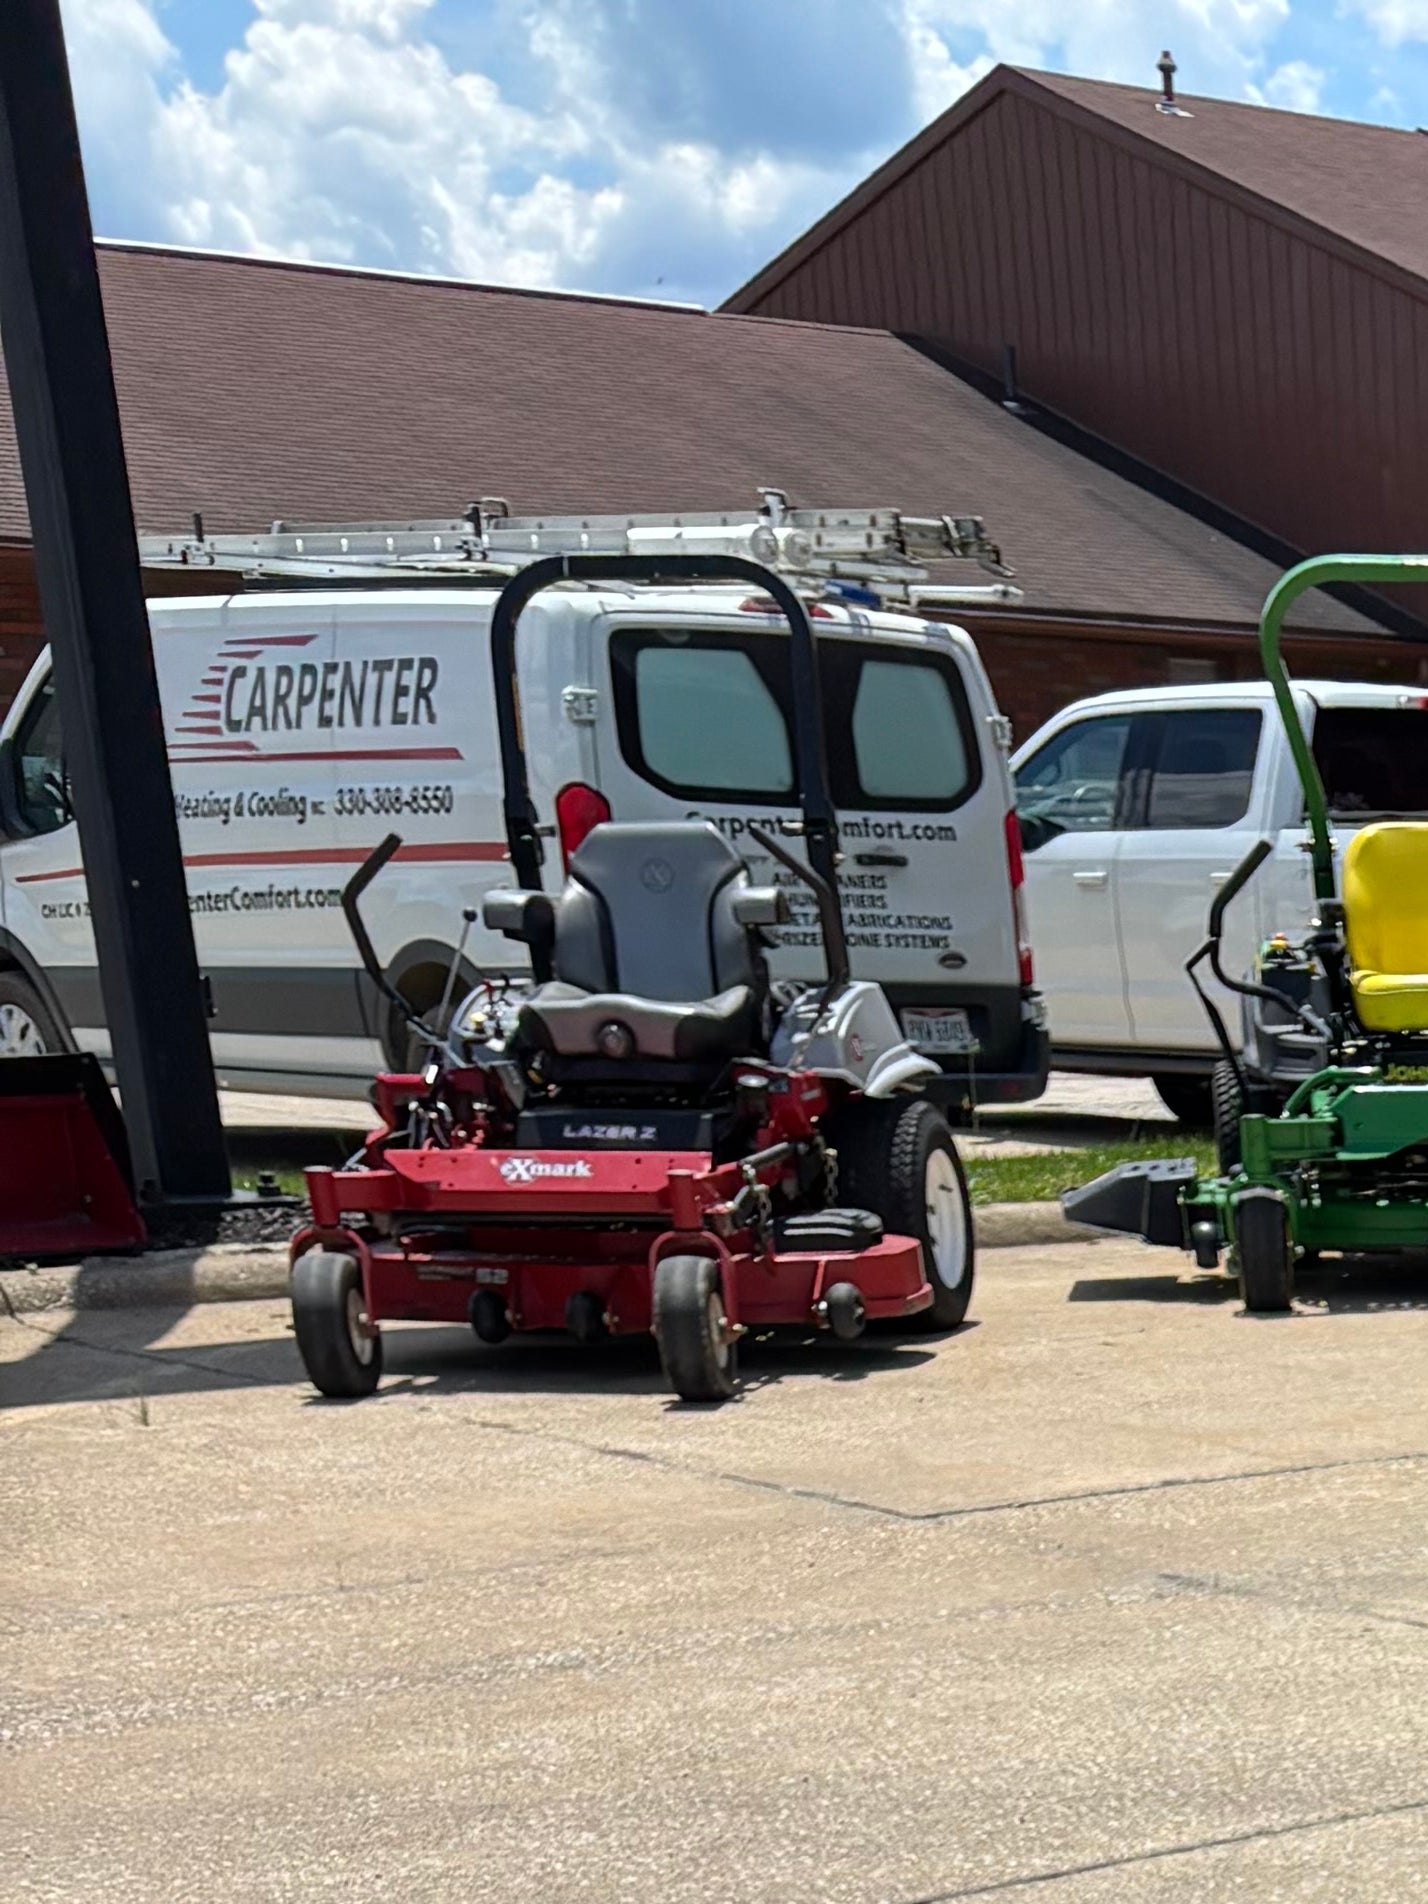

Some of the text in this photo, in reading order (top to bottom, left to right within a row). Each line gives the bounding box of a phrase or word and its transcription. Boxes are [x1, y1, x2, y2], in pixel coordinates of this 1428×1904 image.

[224, 657, 439, 733] CARPENTER
[247, 787, 307, 825] Cooling
[333, 785, 454, 816] 330-308-8550
[847, 914, 953, 931] ABRICATIONS
[562, 1124, 658, 1141] LAZER Z
